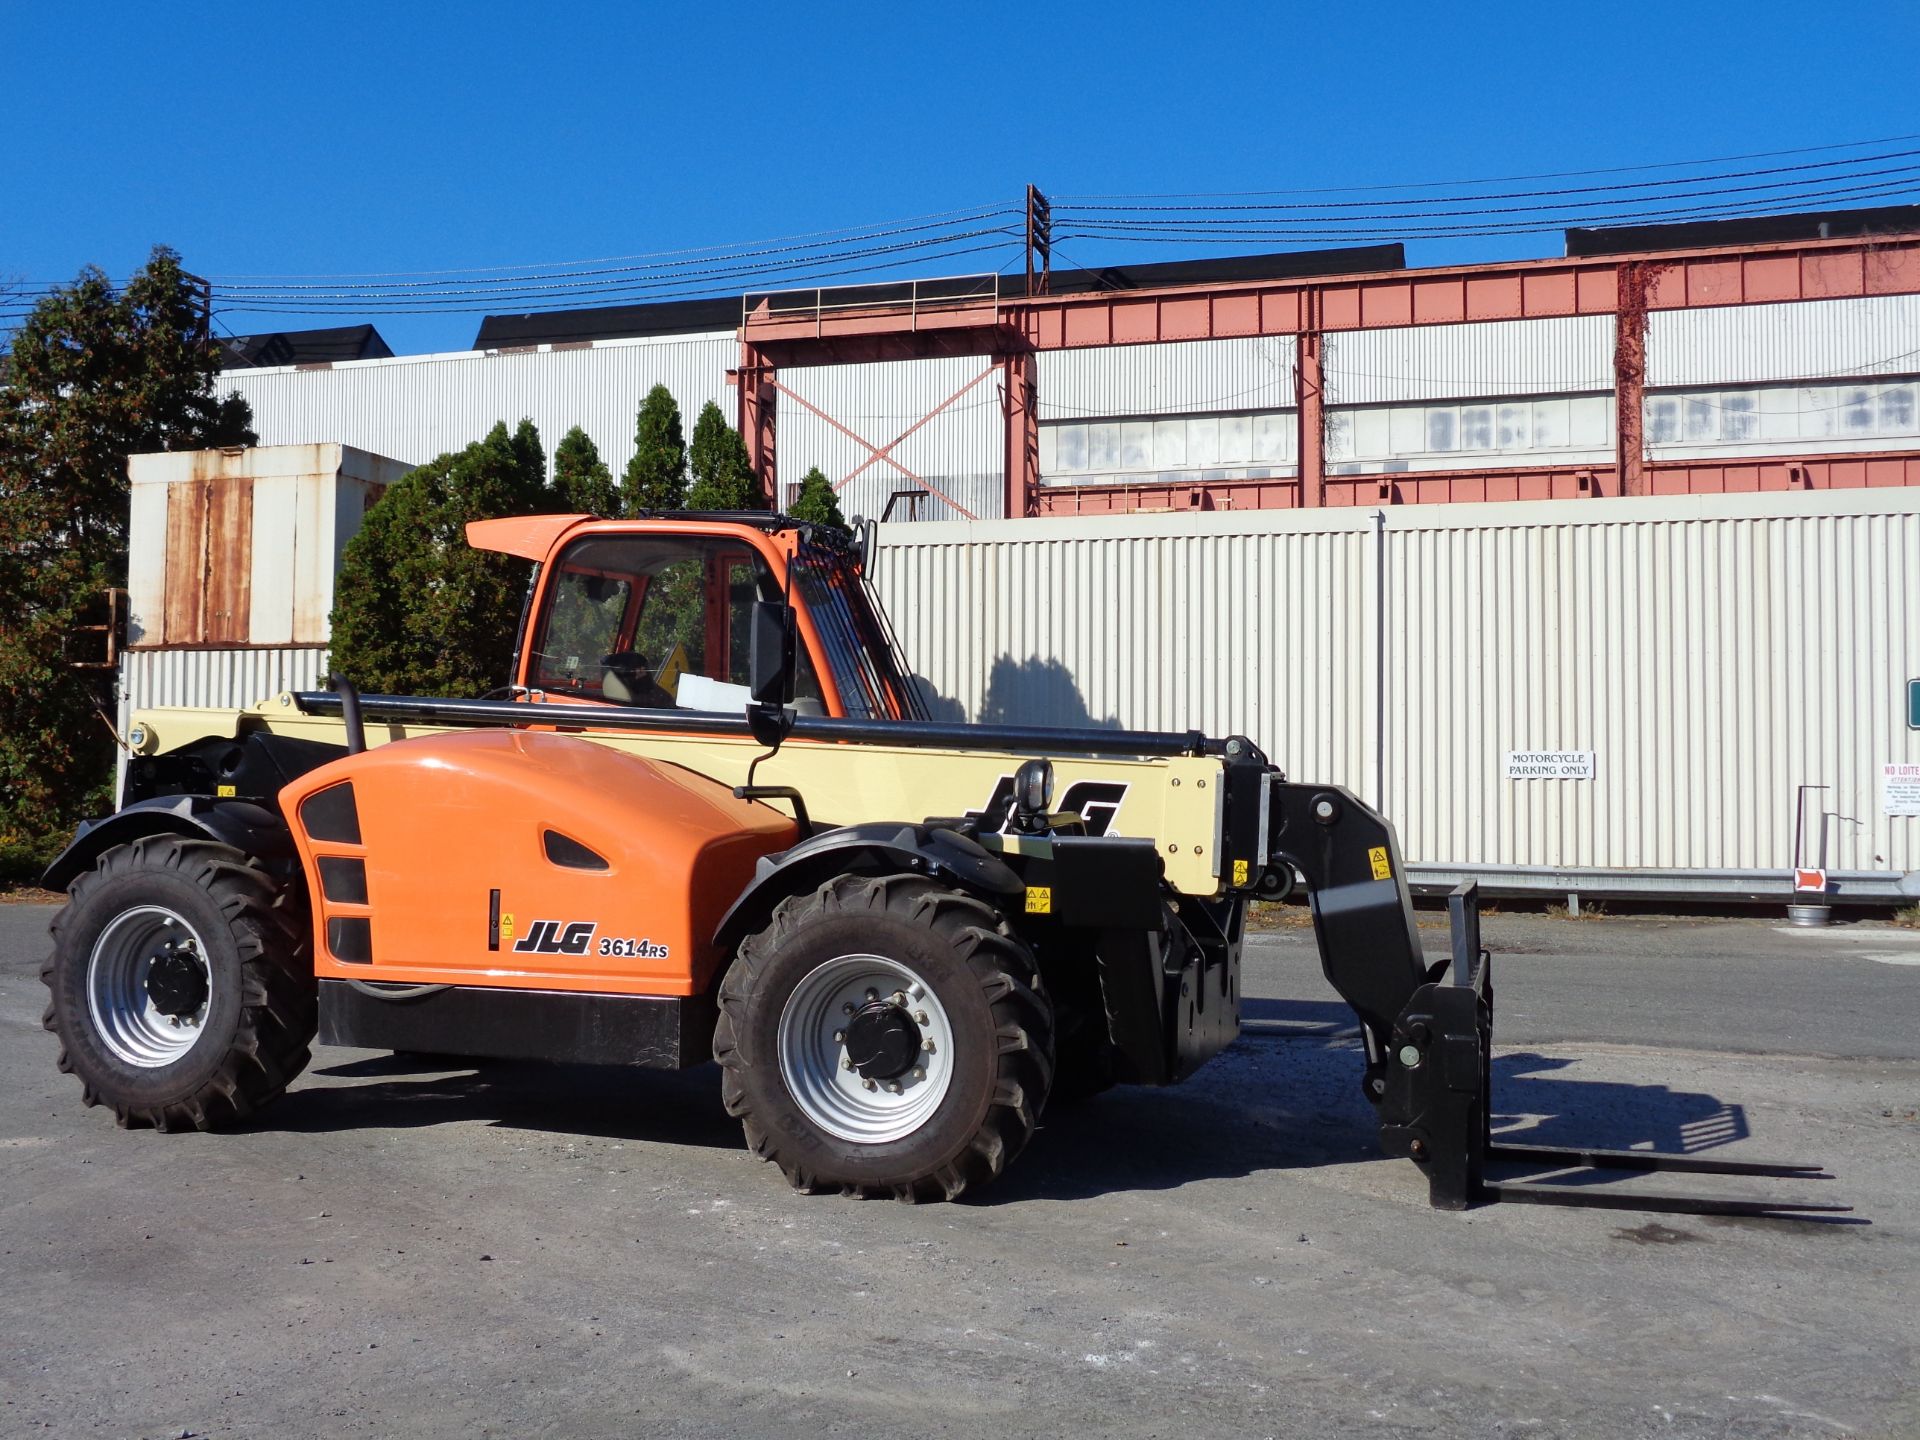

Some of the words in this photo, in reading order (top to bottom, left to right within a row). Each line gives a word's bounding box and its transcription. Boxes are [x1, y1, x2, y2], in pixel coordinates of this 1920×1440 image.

[1512, 754, 1585, 763] MOTORCYCLE
[1509, 766, 1557, 775] PARKING
[1561, 766, 1589, 775] ONLY
[1884, 765, 1895, 776] NO
[513, 920, 597, 955] JLG
[599, 938, 668, 959] 3614RS
